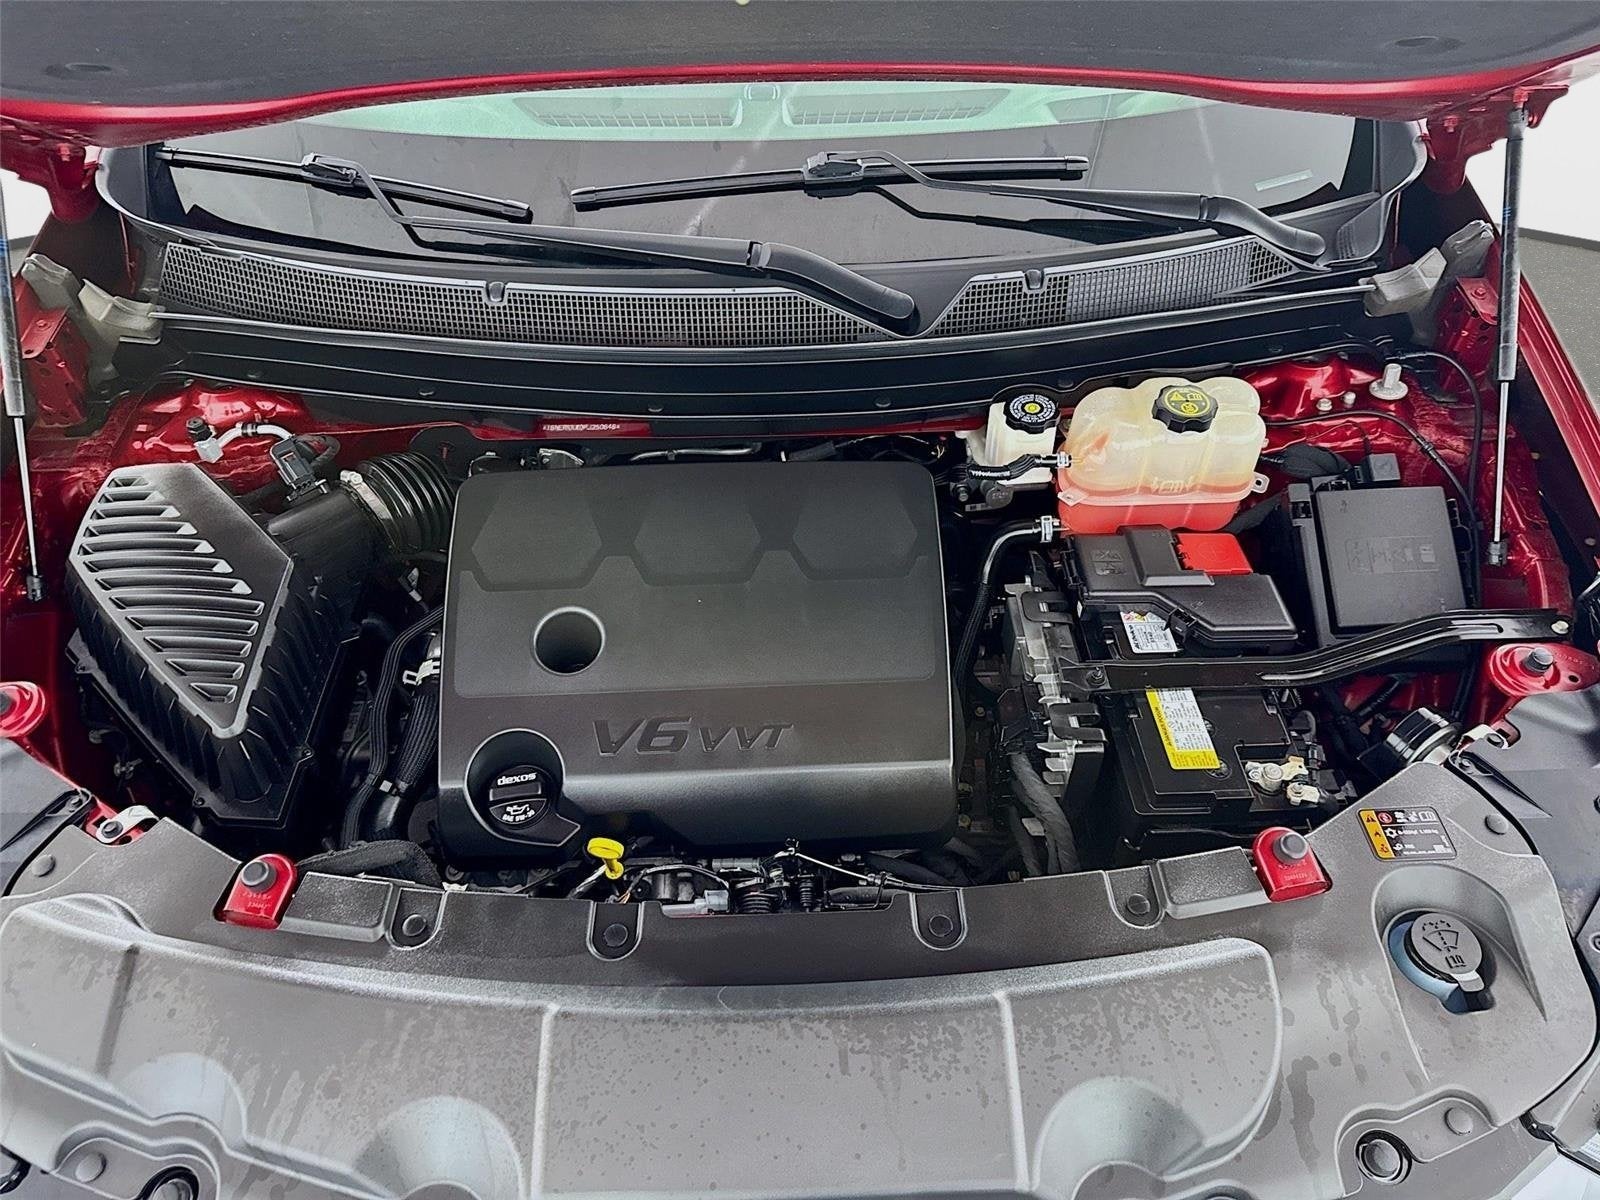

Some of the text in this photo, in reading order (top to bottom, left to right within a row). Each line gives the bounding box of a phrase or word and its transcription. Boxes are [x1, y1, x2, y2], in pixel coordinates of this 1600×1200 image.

[593, 716, 794, 756] V6 VVT
[497, 772, 537, 786] dexos
